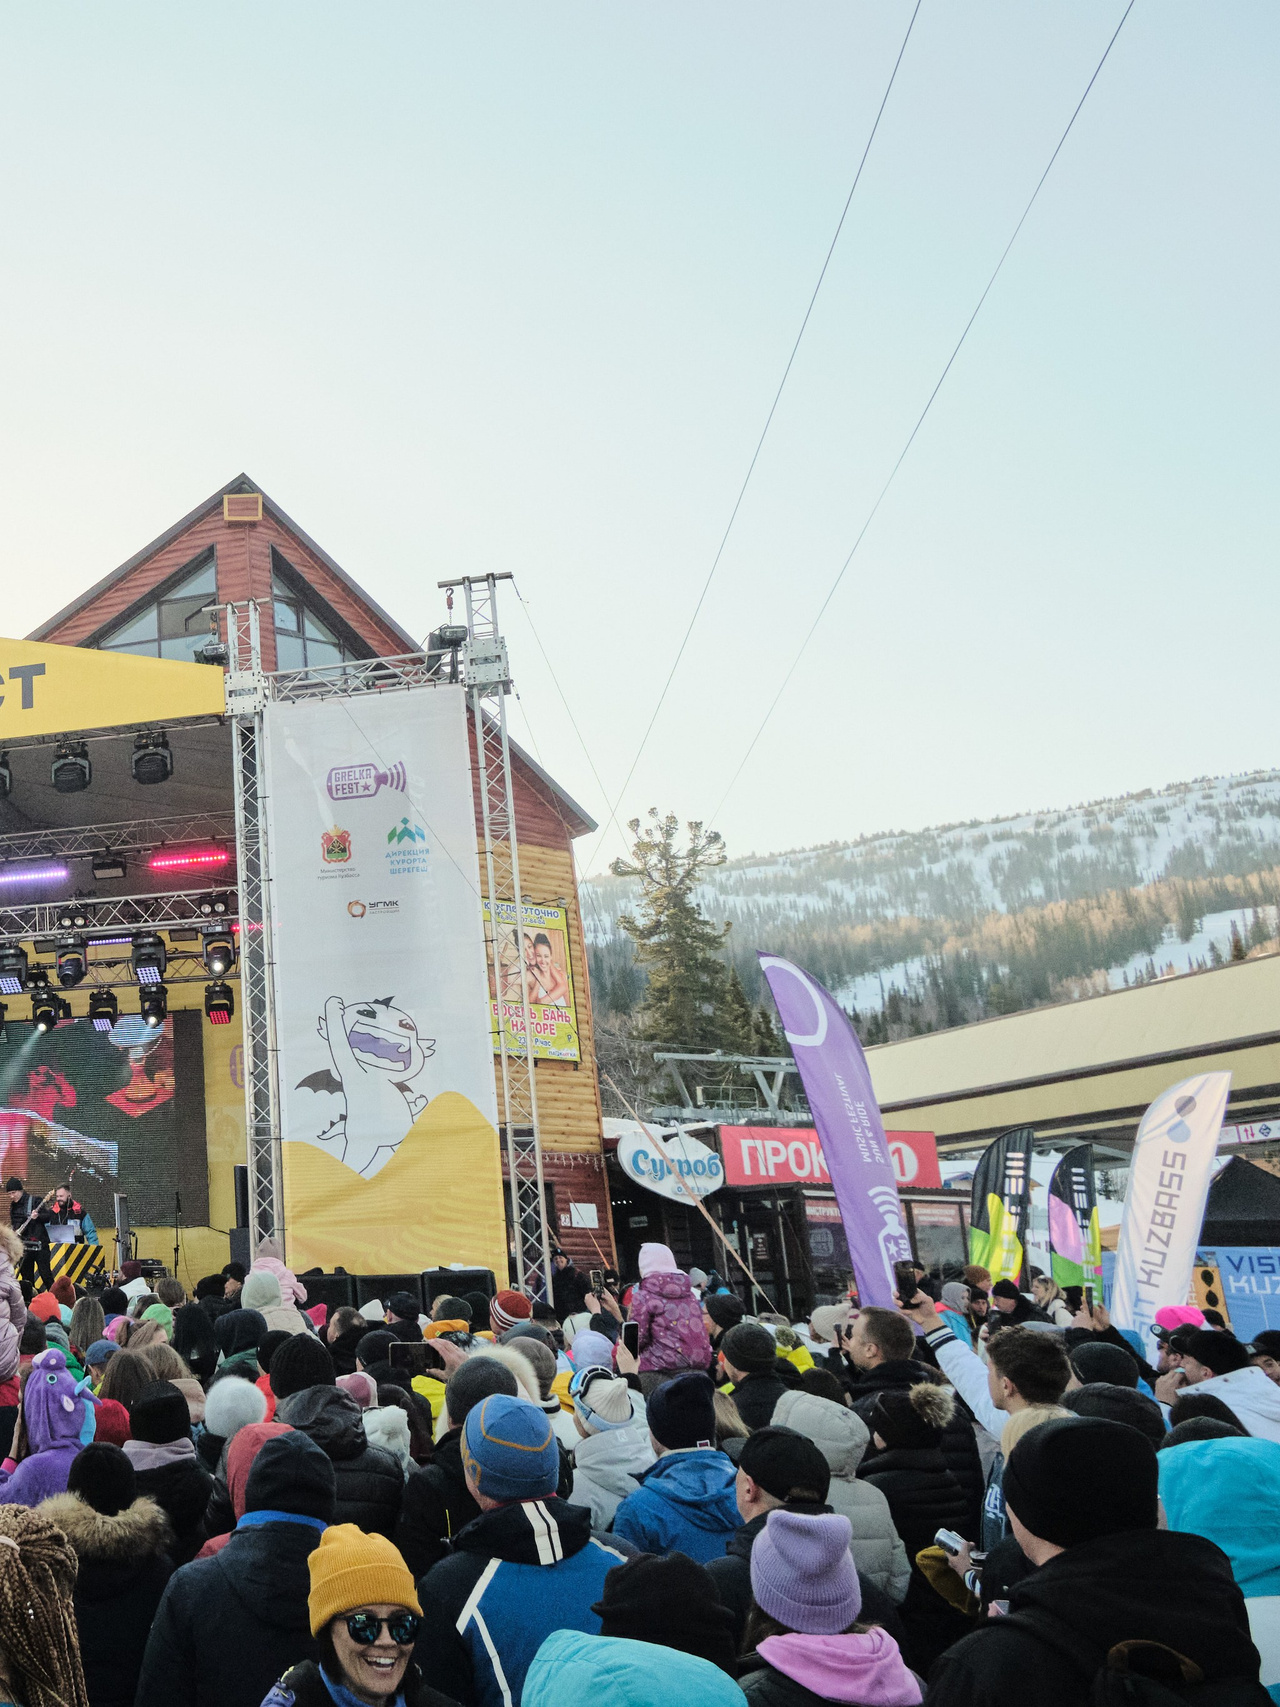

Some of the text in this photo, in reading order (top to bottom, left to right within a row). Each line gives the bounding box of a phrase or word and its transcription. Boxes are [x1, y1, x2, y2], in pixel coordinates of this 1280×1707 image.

[334, 768, 372, 783] GRELKA
[335, 782, 360, 795] FEST
[385, 848, 430, 859] ДИРЕКЦИЯ
[390, 857, 427, 866] КУРОРТА
[389, 866, 428, 875] ШЕРЕГЕШ
[542, 1008, 571, 1023] БАНЬ
[631, 1149, 721, 1181] Сугроб
[740, 1138, 830, 1178] ПРОК
[1137, 1149, 1188, 1289] KUZBASS
